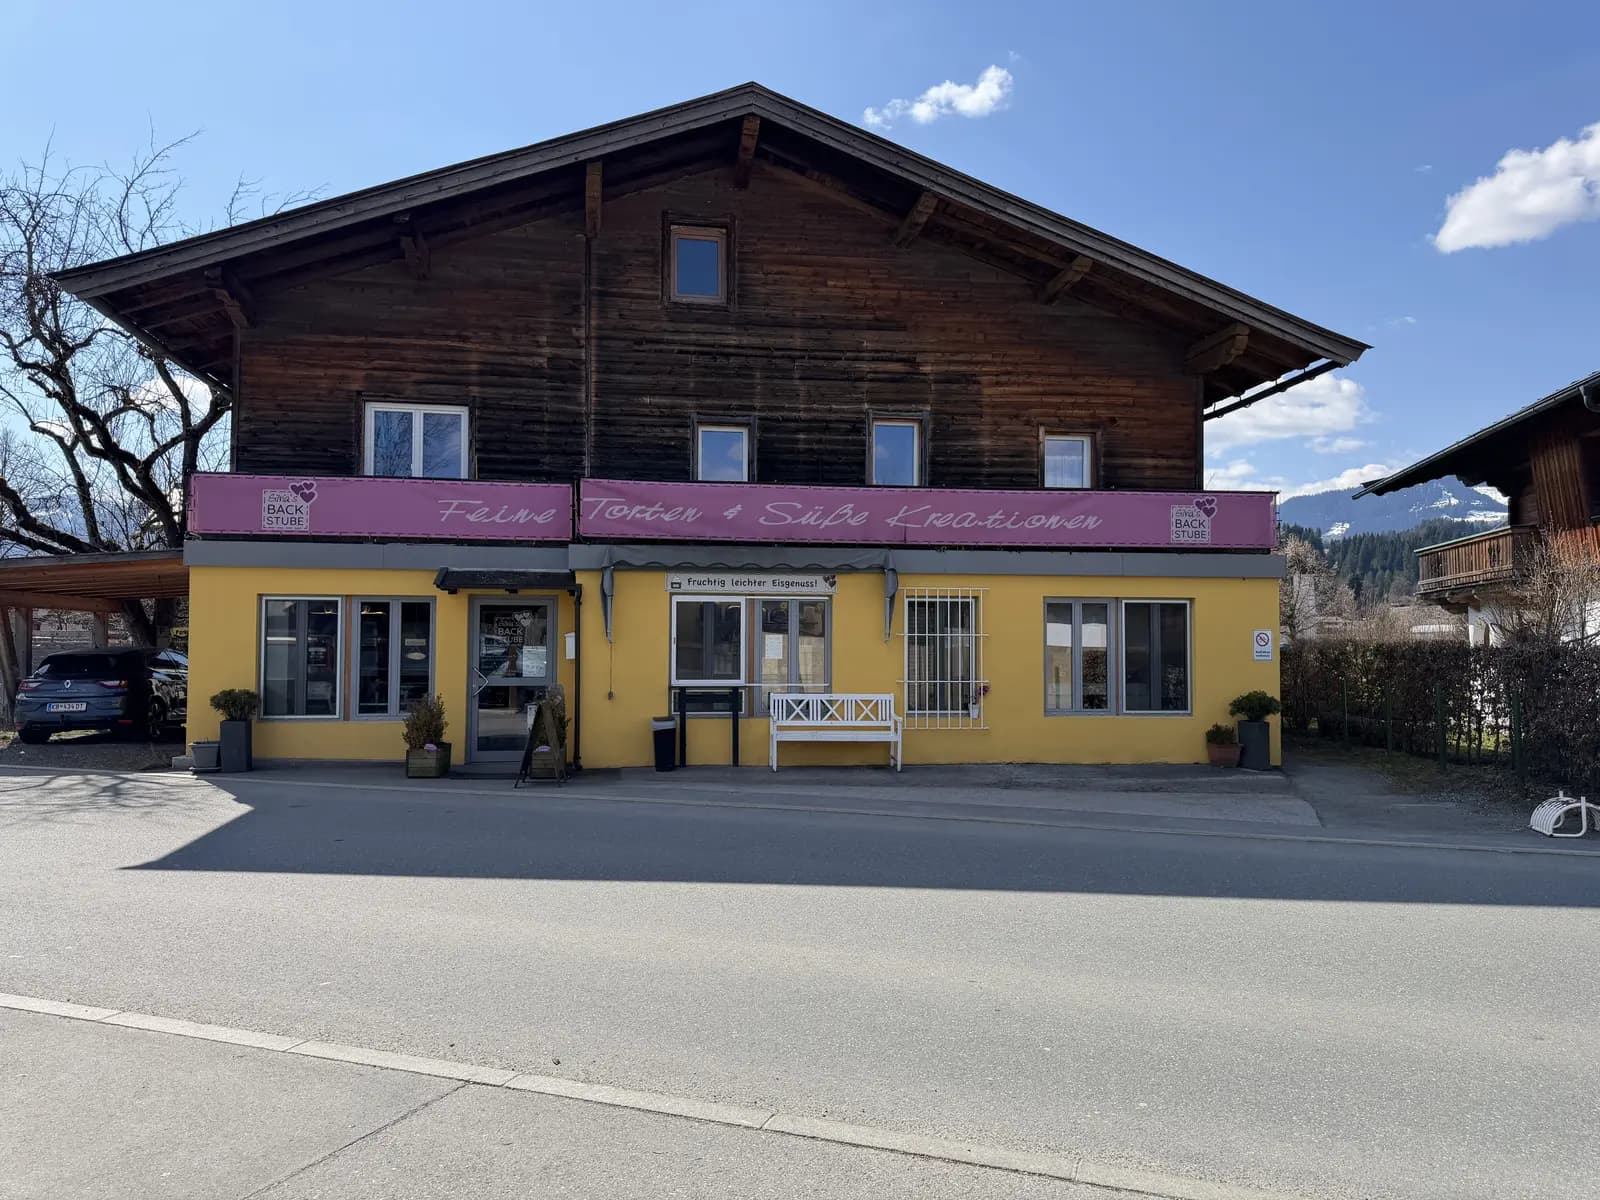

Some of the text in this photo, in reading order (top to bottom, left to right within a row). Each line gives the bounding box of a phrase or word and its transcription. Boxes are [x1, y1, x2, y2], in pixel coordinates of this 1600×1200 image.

[267, 504, 304, 515] BACK
[437, 497, 1103, 529] Feine Torten & Süße Kreationen
[266, 516, 305, 526] STUBE
[1175, 519, 1206, 529] BACK
[1174, 530, 1207, 539] STUBE
[687, 577, 818, 588] Fruchtig leichter Eisgenuss!
